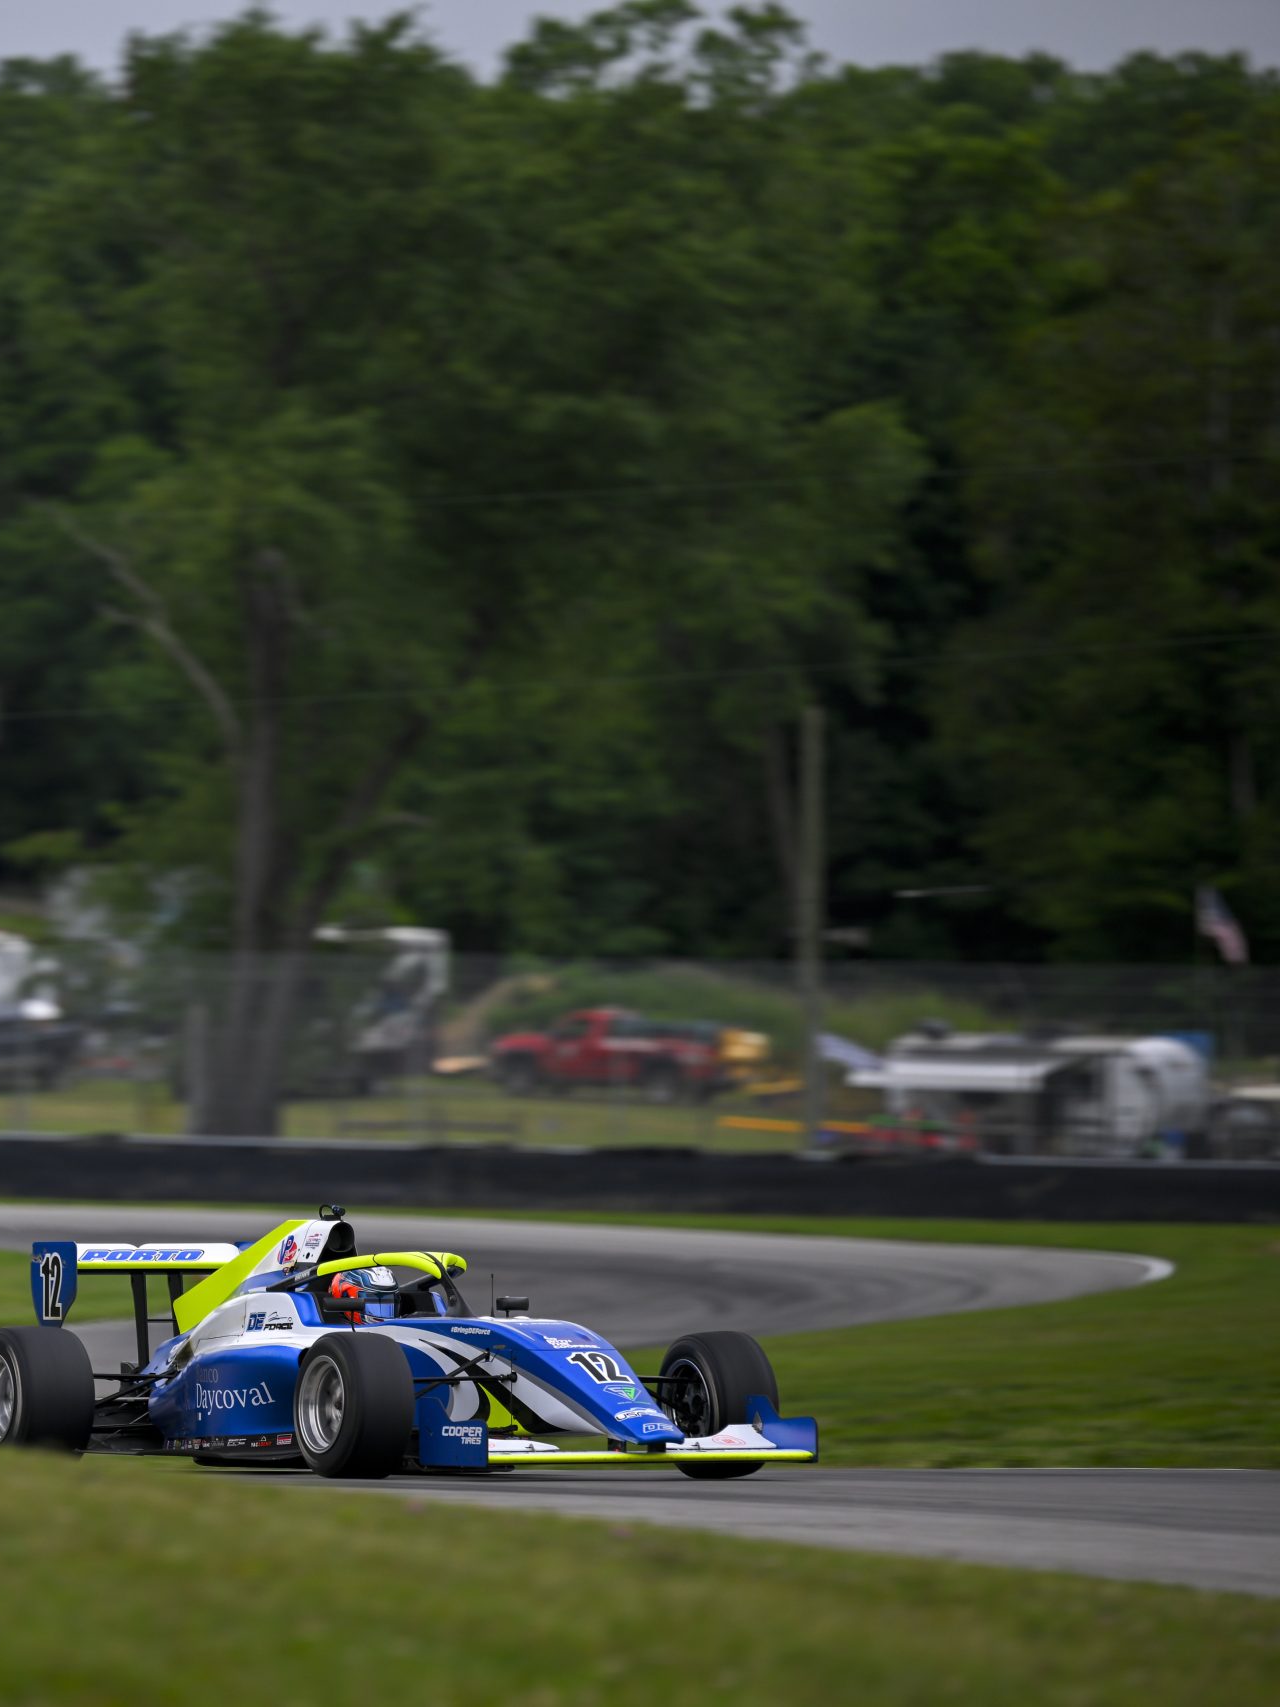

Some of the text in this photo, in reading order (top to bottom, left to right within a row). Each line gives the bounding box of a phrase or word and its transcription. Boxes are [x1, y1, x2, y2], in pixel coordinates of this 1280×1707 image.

[79, 1249, 205, 1261] PORTO
[40, 1252, 63, 1321] 12
[246, 1312, 294, 1332] DE FORCE
[566, 1351, 635, 1385] 12
[196, 1381, 276, 1416] Daycoval
[442, 1426, 483, 1437] COOPER
[461, 1437, 482, 1445] TIRES
